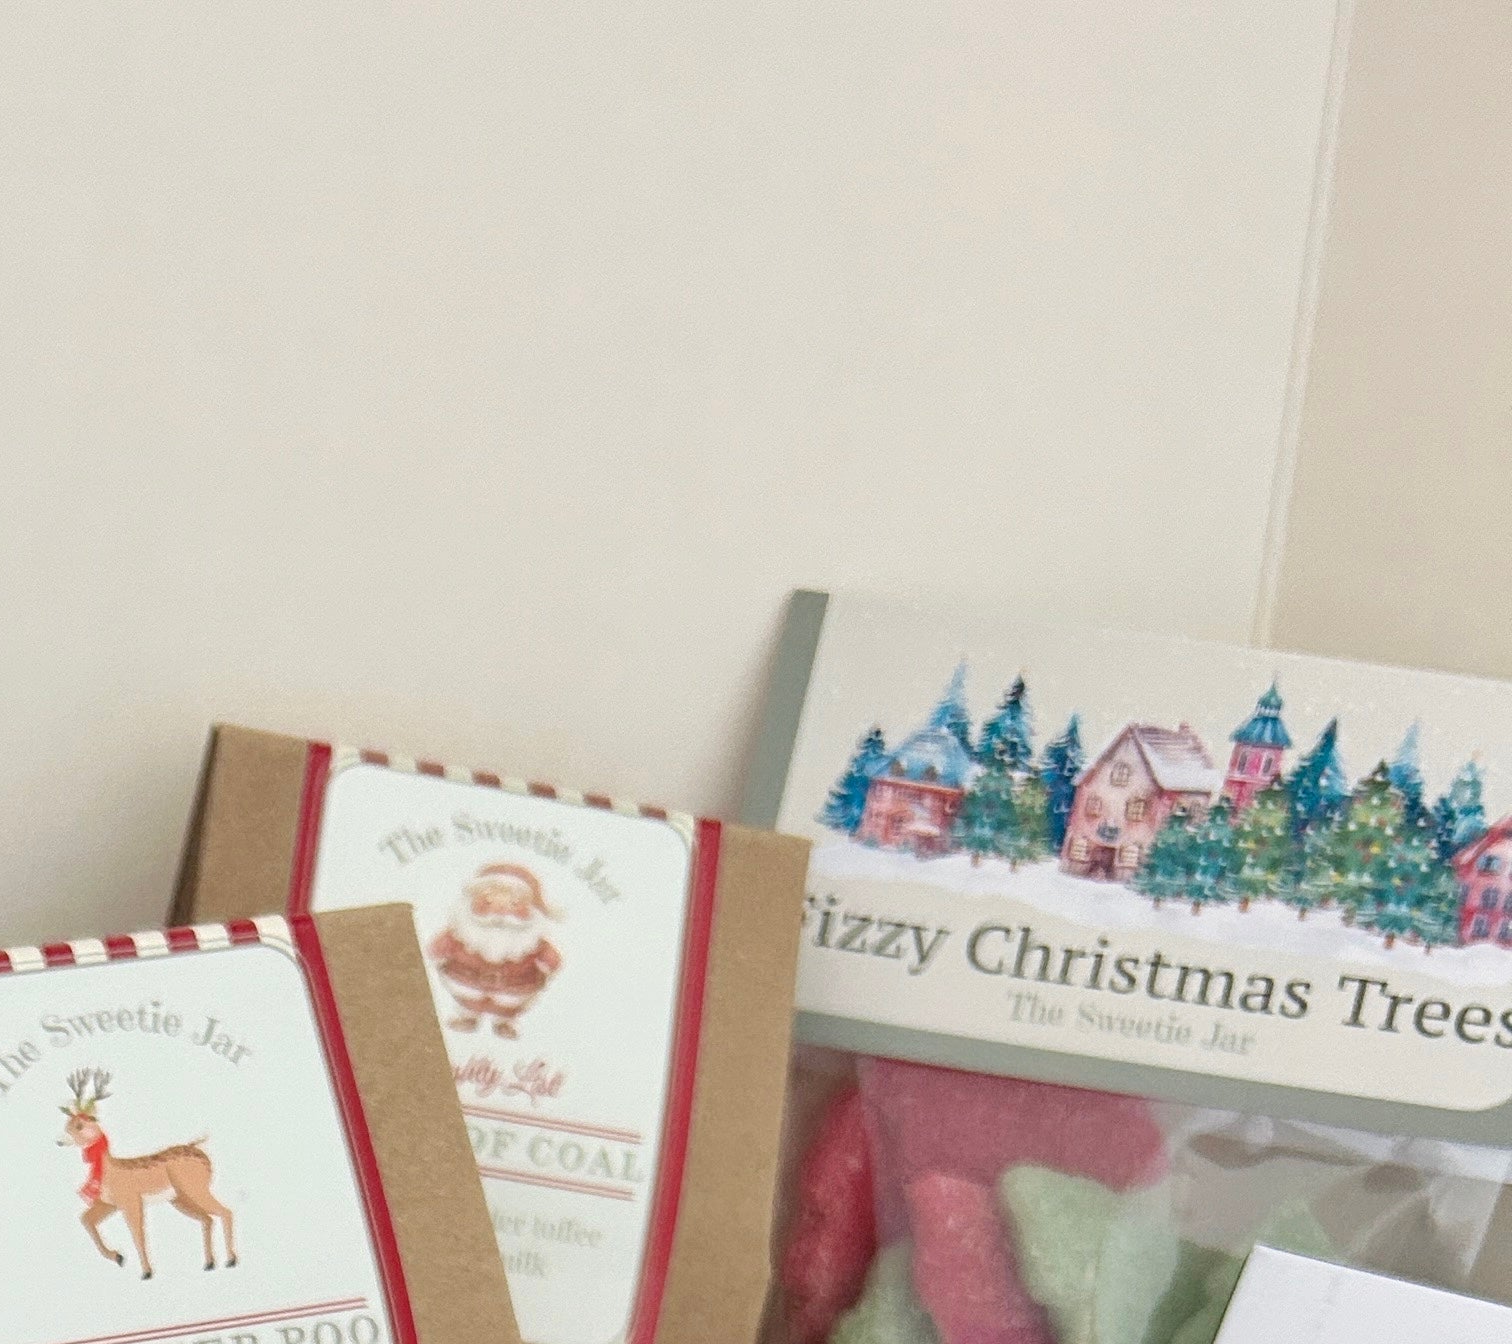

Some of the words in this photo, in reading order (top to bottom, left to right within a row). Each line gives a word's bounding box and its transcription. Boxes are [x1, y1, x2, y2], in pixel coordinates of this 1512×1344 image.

[378, 828, 444, 868] The
[802, 894, 951, 976] izzy
[966, 922, 1312, 1020] Christmas
[41, 1001, 185, 1049] Sweetie
[191, 1016, 254, 1067] Jar
[1008, 990, 1066, 1028] The
[1076, 999, 1192, 1051] Sweetie
[1199, 1018, 1258, 1057] Jar
[529, 1134, 644, 1184] COAL
